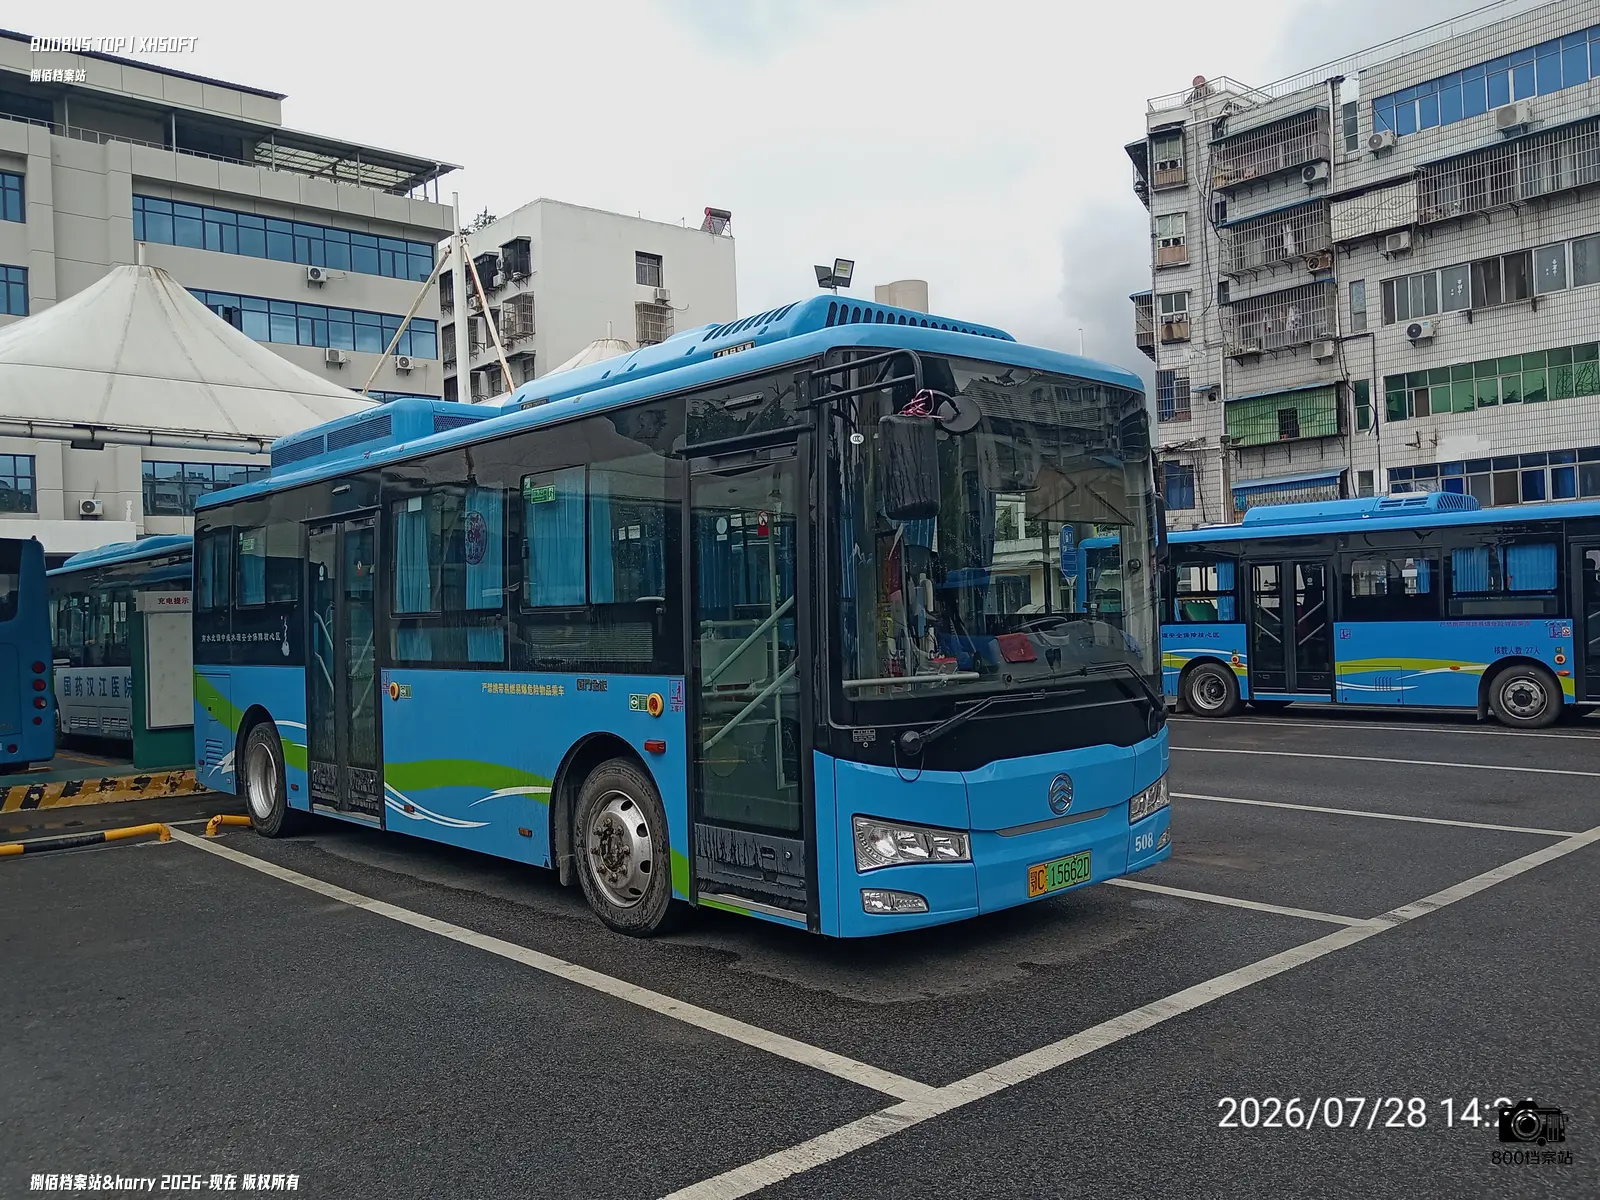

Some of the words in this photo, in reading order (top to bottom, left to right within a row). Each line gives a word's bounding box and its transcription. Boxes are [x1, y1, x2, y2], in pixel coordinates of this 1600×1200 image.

[157, 597, 190, 605] 充电提示
[63, 676, 132, 699] 国药汉江医院
[1135, 832, 1154, 852] 508
